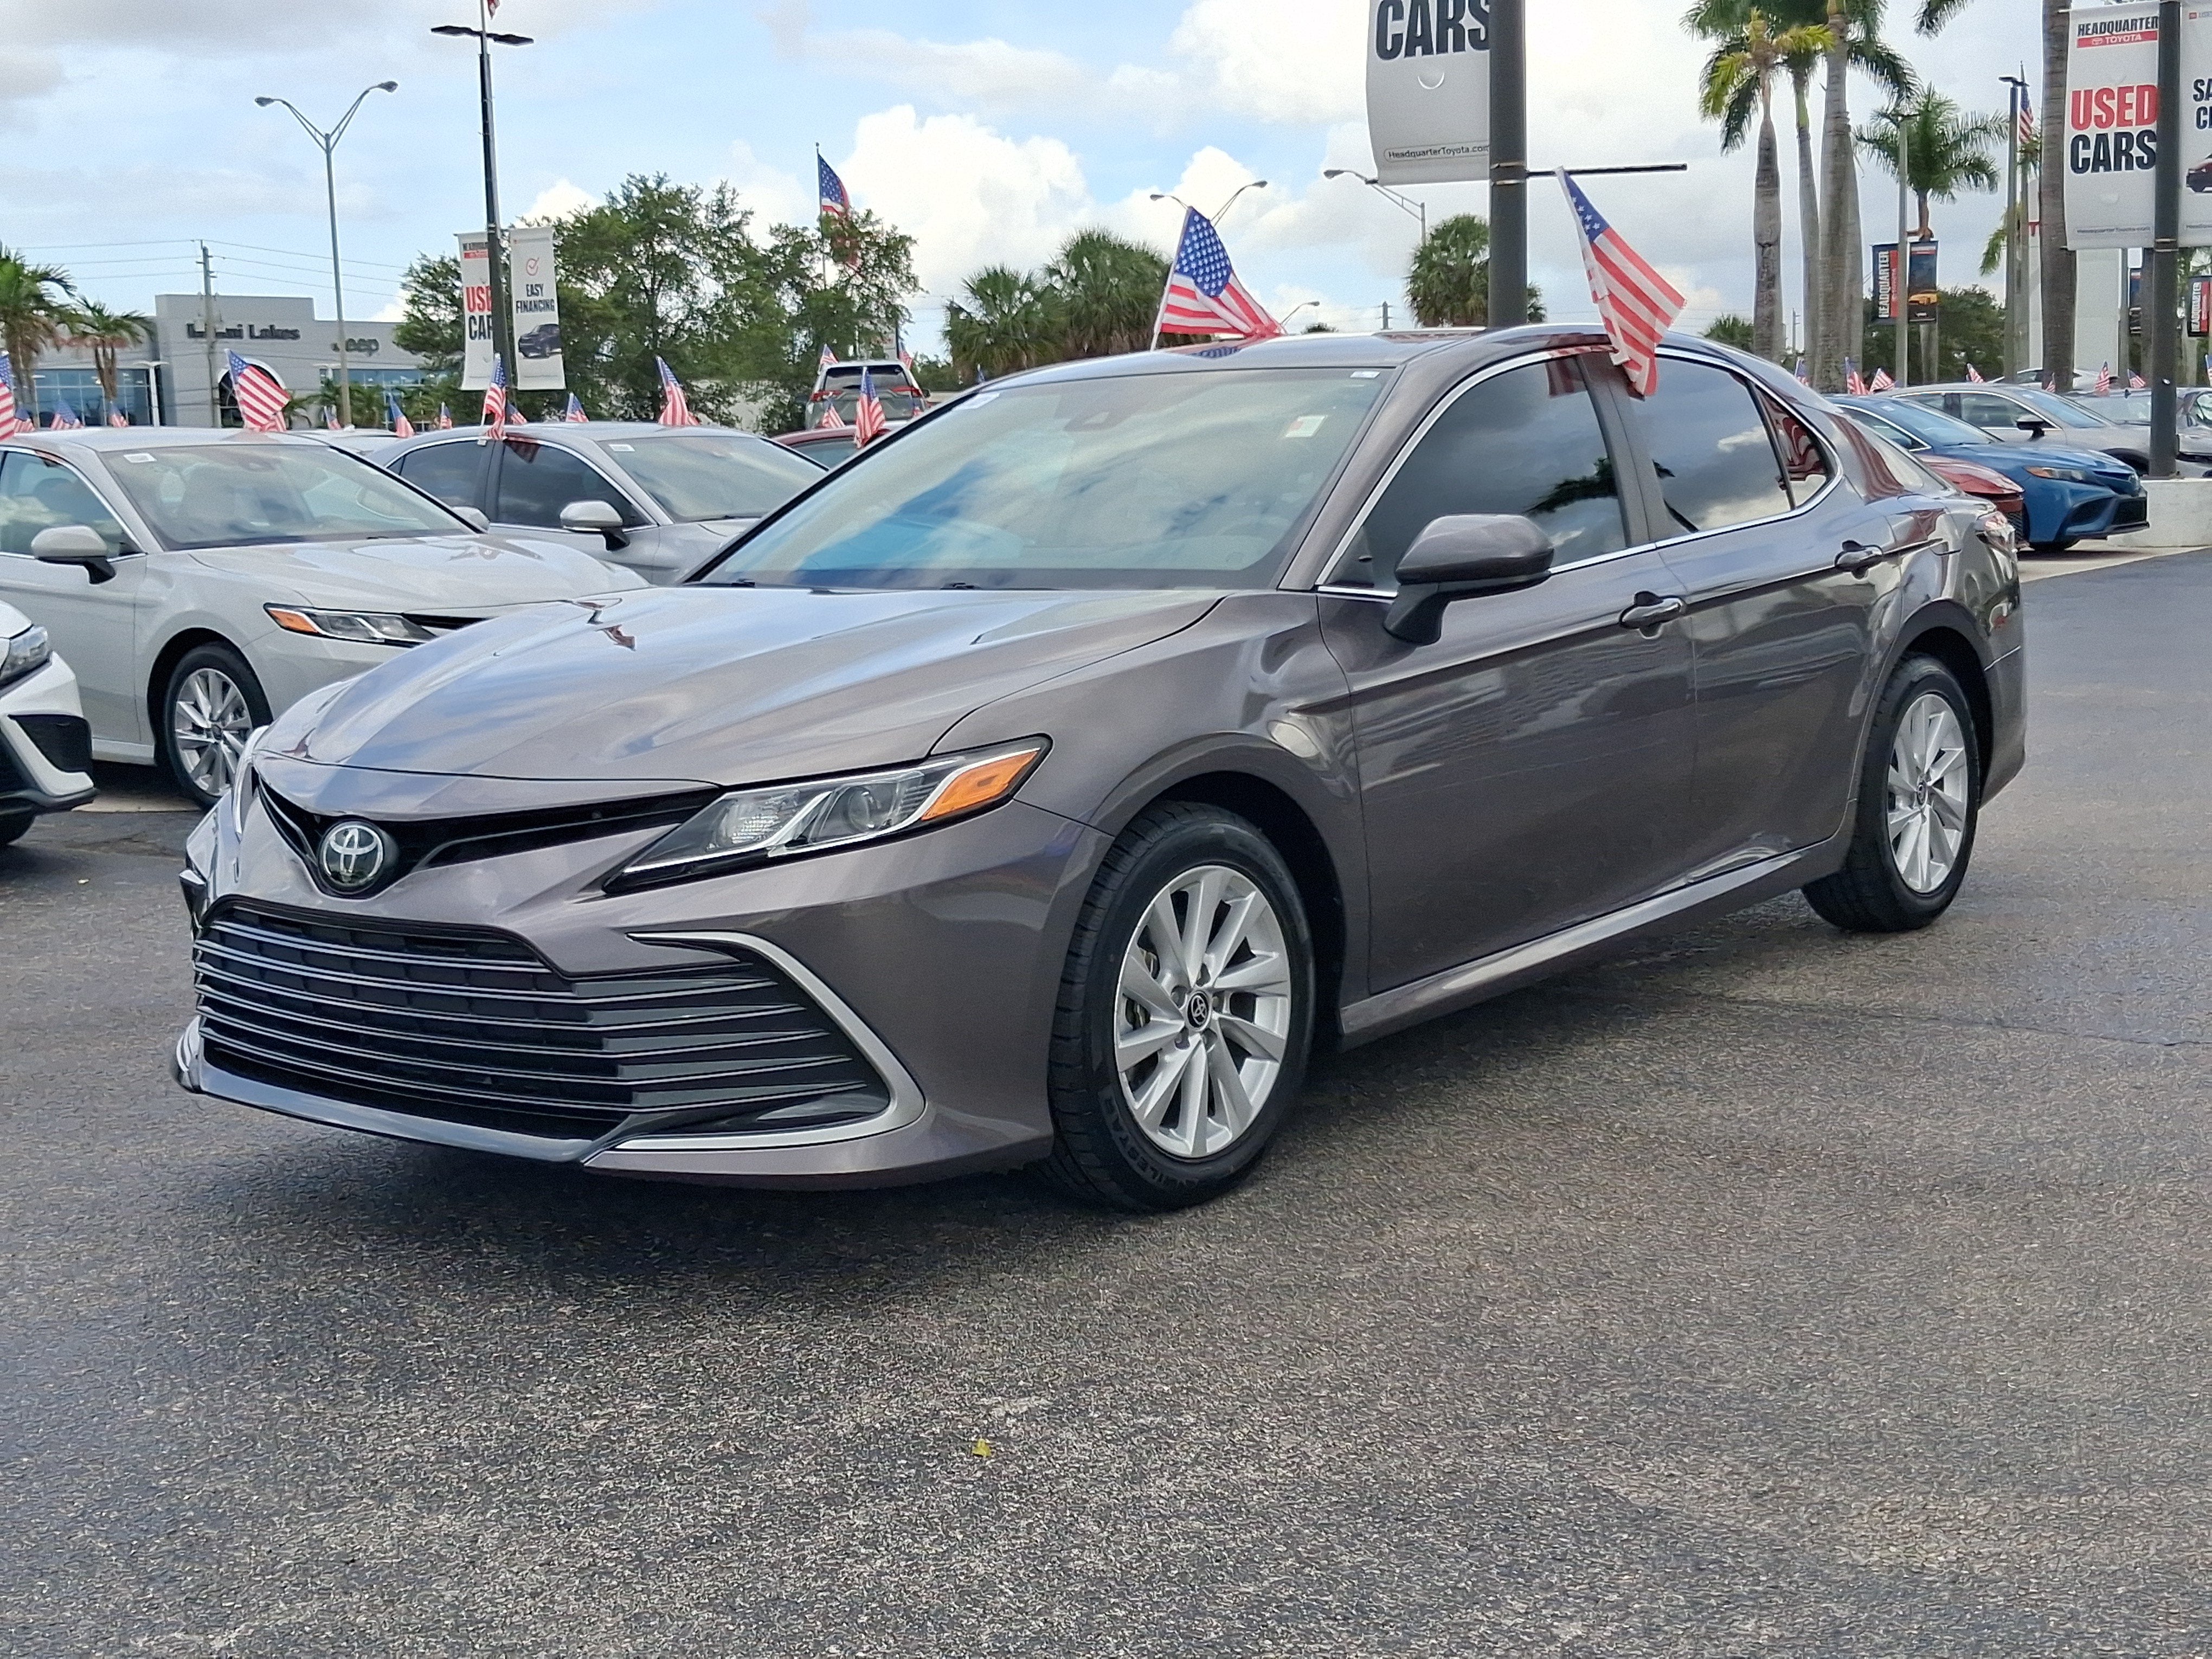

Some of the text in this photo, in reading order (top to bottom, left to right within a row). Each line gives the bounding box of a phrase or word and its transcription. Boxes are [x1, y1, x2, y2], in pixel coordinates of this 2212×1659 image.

[1376, 0, 1490, 60] CARS
[2078, 16, 2159, 36] HEADQUARTER
[2105, 34, 2142, 44] TOYOTA
[2070, 84, 2158, 131] USED
[2070, 129, 2157, 174] CARS
[466, 286, 492, 313] USE
[526, 284, 544, 297] EASY
[516, 298, 555, 313] FINANCING
[468, 315, 493, 340] CAR
